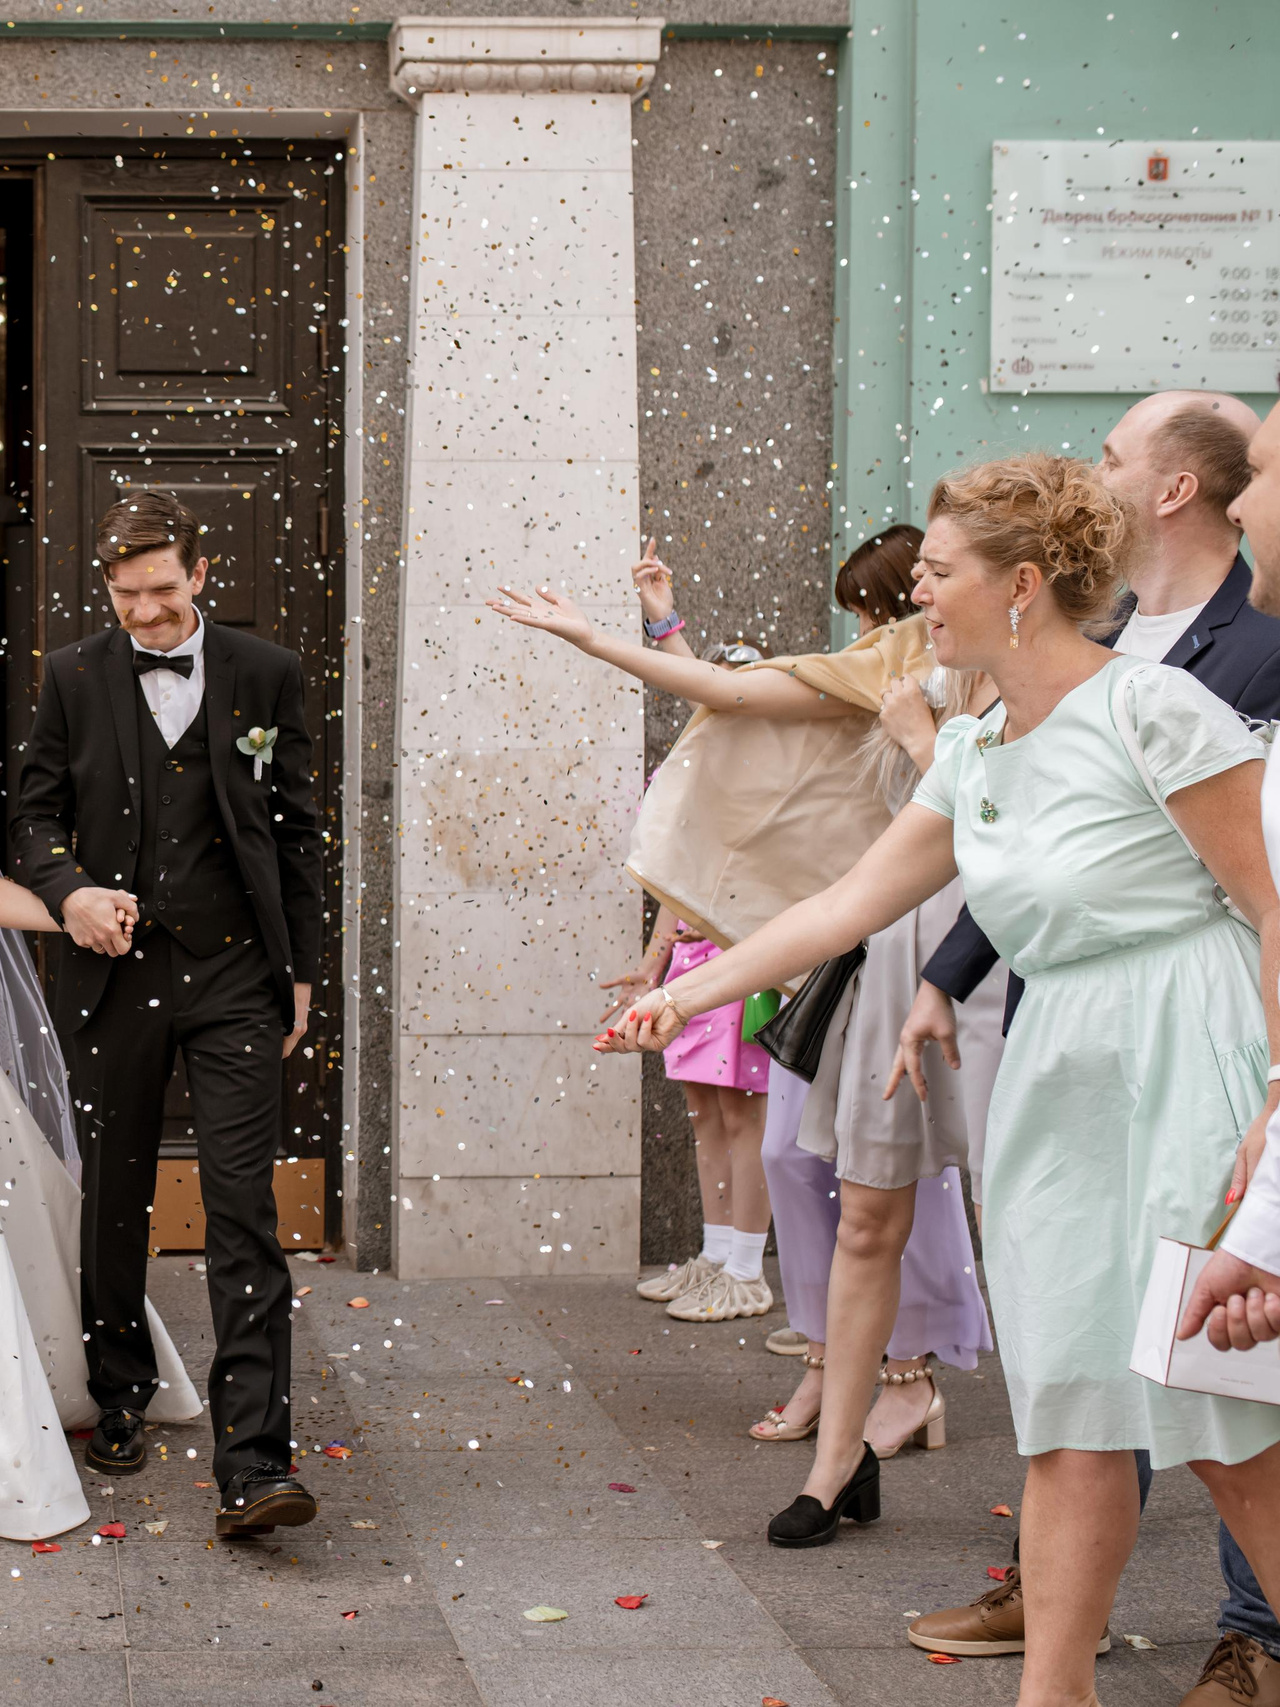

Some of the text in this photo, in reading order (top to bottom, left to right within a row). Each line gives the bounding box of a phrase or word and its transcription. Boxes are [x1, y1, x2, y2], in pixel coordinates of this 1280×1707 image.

[1042, 208, 1103, 226] Дворец
[1102, 246, 1213, 259] РЕЖИМ РАБОТЫ
